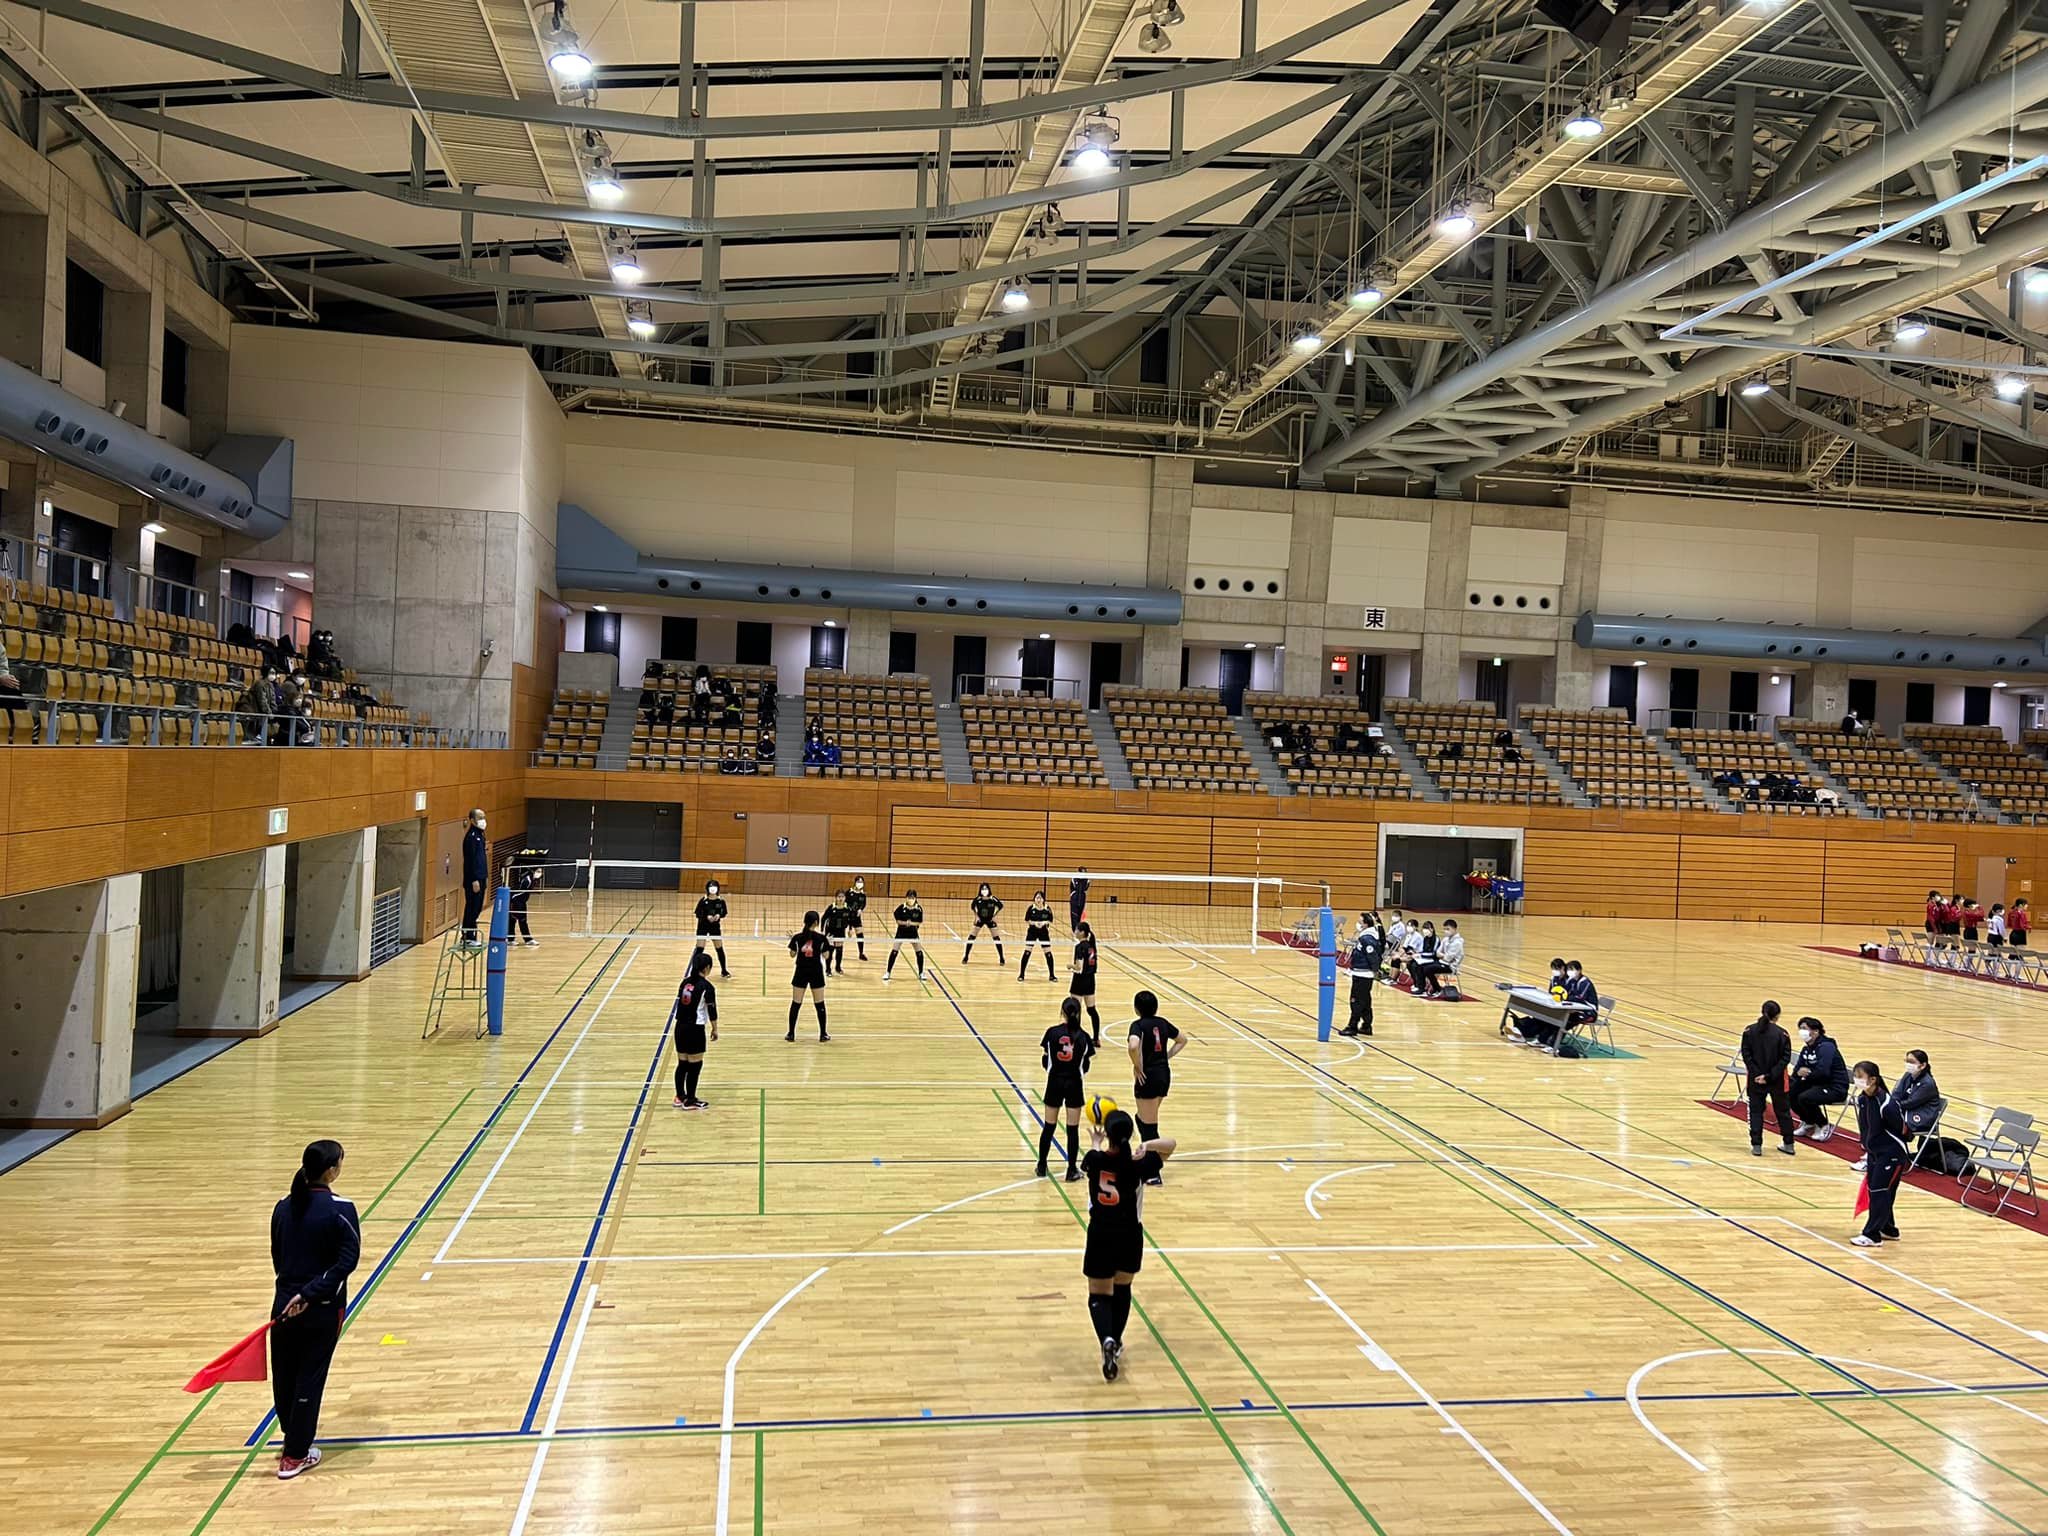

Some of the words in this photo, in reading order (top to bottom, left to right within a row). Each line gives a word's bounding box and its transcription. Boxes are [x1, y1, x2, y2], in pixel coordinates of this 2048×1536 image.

[1365, 608, 1386, 628] 東
[801, 940, 814, 958] 4
[681, 983, 695, 1005] 6
[1057, 1035, 1074, 1062] 3
[1152, 1026, 1162, 1052] 1
[1097, 1170, 1120, 1206] 5
